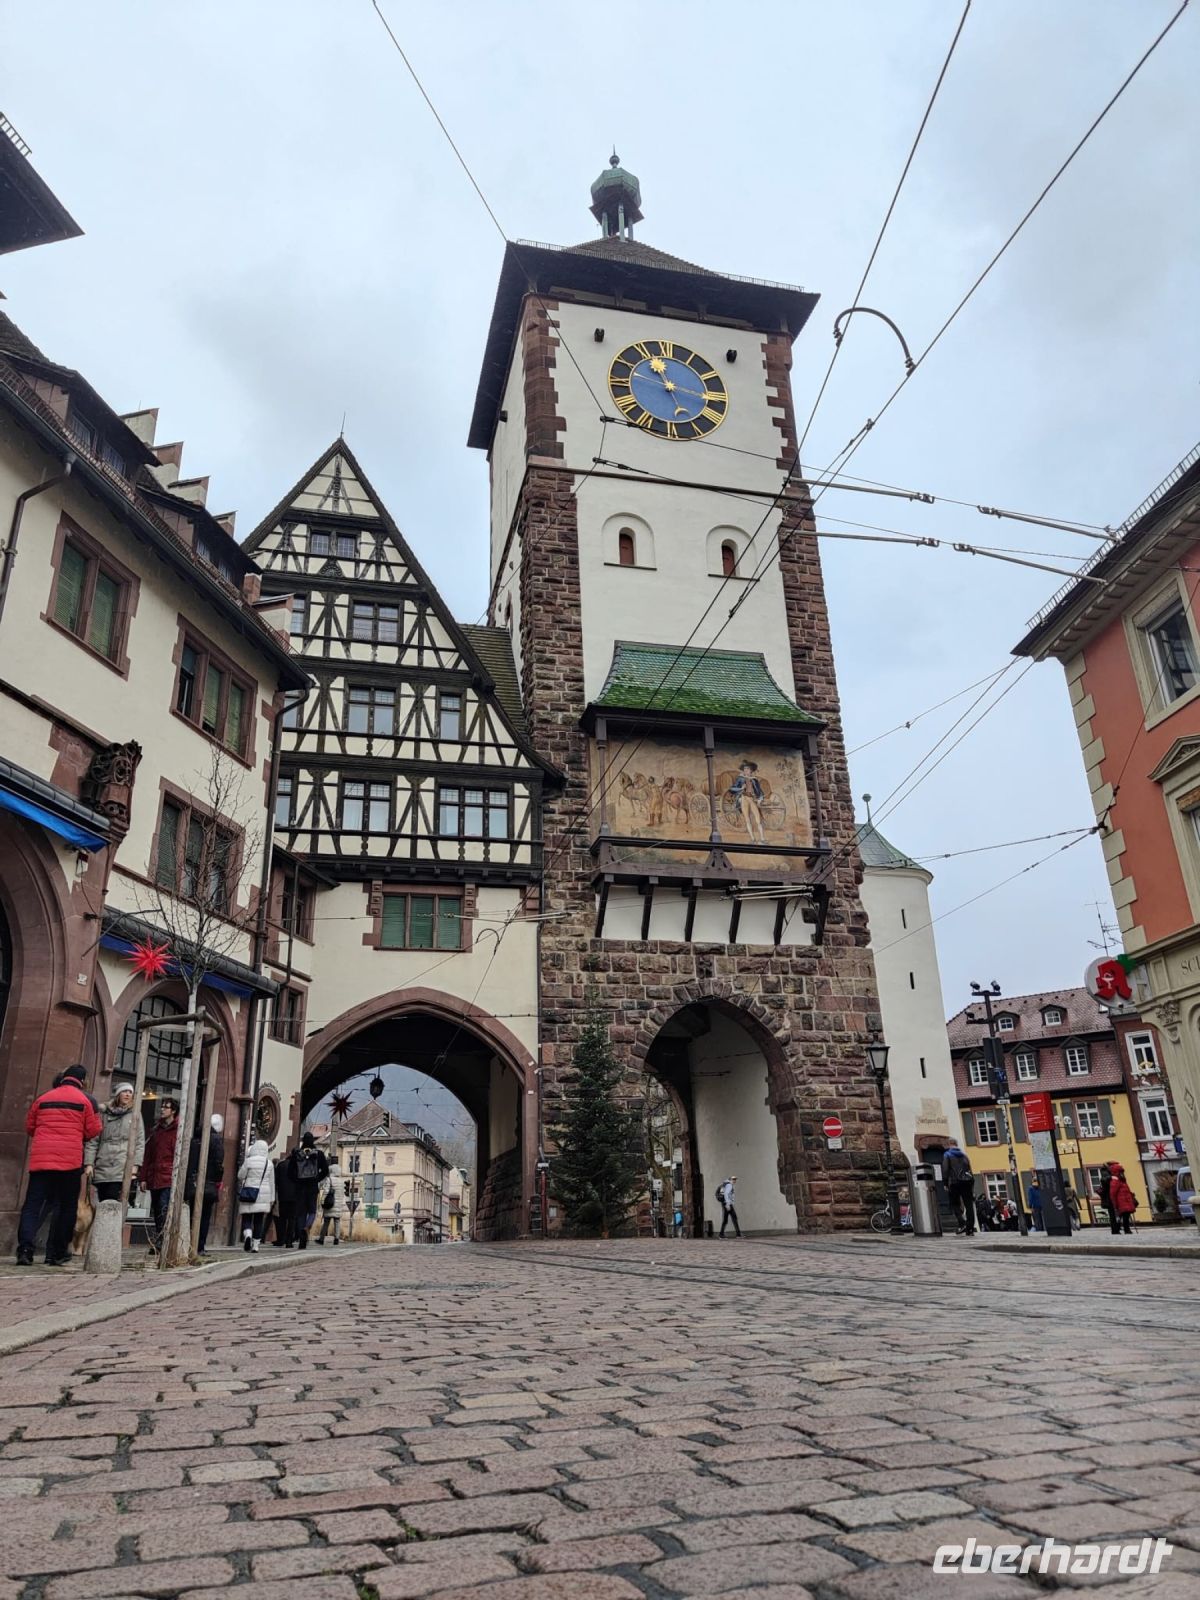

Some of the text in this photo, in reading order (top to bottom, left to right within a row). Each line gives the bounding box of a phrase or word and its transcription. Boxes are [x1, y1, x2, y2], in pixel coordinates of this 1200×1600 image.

[632, 342, 651, 359] XI
[659, 341, 674, 358] XII
[614, 355, 635, 370] X
[685, 352, 696, 365] I
[610, 375, 630, 386] IX
[700, 370, 718, 380] II
[615, 394, 638, 414] VIII
[636, 411, 654, 429] VII
[690, 420, 704, 436] V
[666, 421, 679, 438] VI
